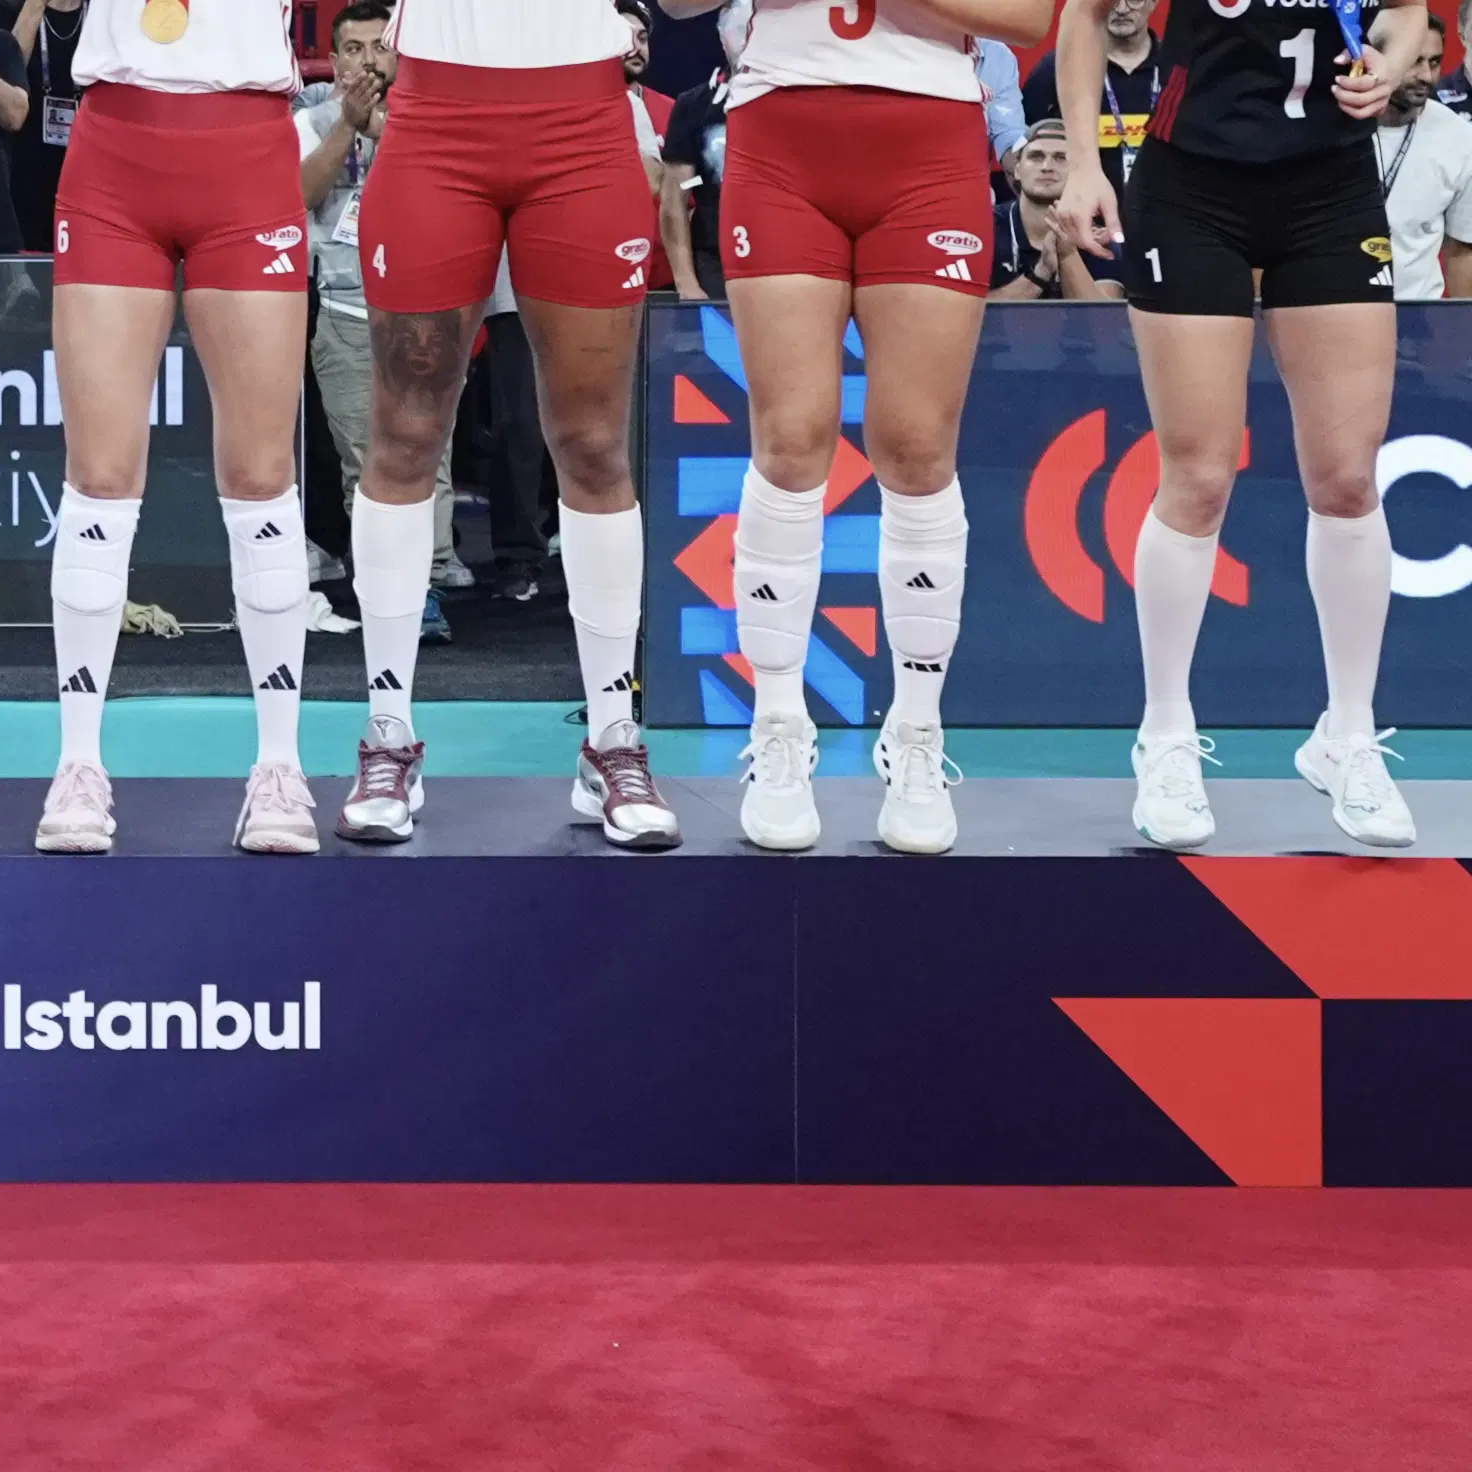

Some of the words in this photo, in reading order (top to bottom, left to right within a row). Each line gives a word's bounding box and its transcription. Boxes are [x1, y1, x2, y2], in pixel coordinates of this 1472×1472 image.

[1279, 28, 1316, 119] 1
[57, 220, 69, 254] 6
[733, 225, 751, 258] 3
[936, 234, 979, 248] gratis
[372, 243, 387, 278] 4
[1145, 247, 1163, 283] 1
[3, 980, 321, 1051] Istanbul
